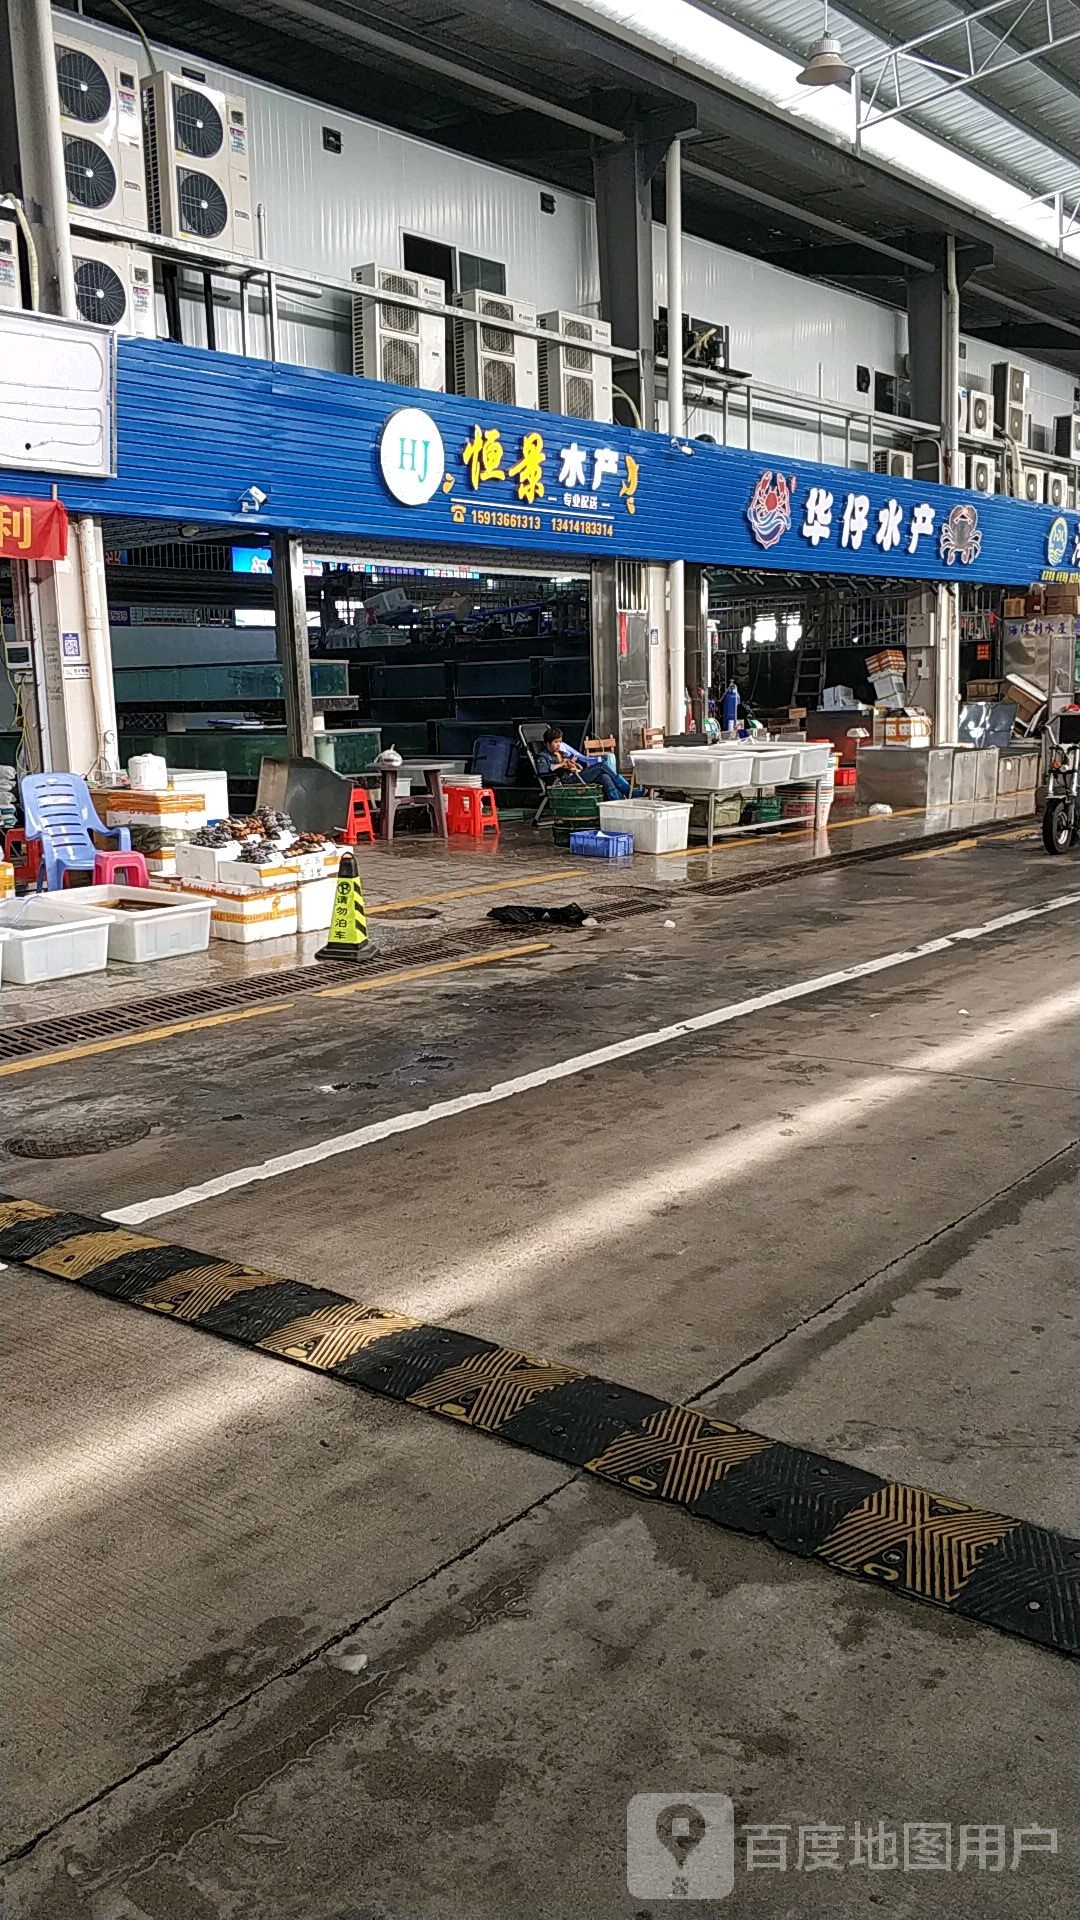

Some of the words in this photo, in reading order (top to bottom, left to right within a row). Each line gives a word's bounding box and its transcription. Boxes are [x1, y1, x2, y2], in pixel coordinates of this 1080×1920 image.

[399, 437, 430, 483] HJ
[463, 424, 619, 504] 恒景水产
[471, 510, 541, 531] 15913661313
[563, 492, 598, 511] 专业配送
[802, 487, 936, 554] 华仔水产
[334, 895, 348, 939] 请勿泊车
